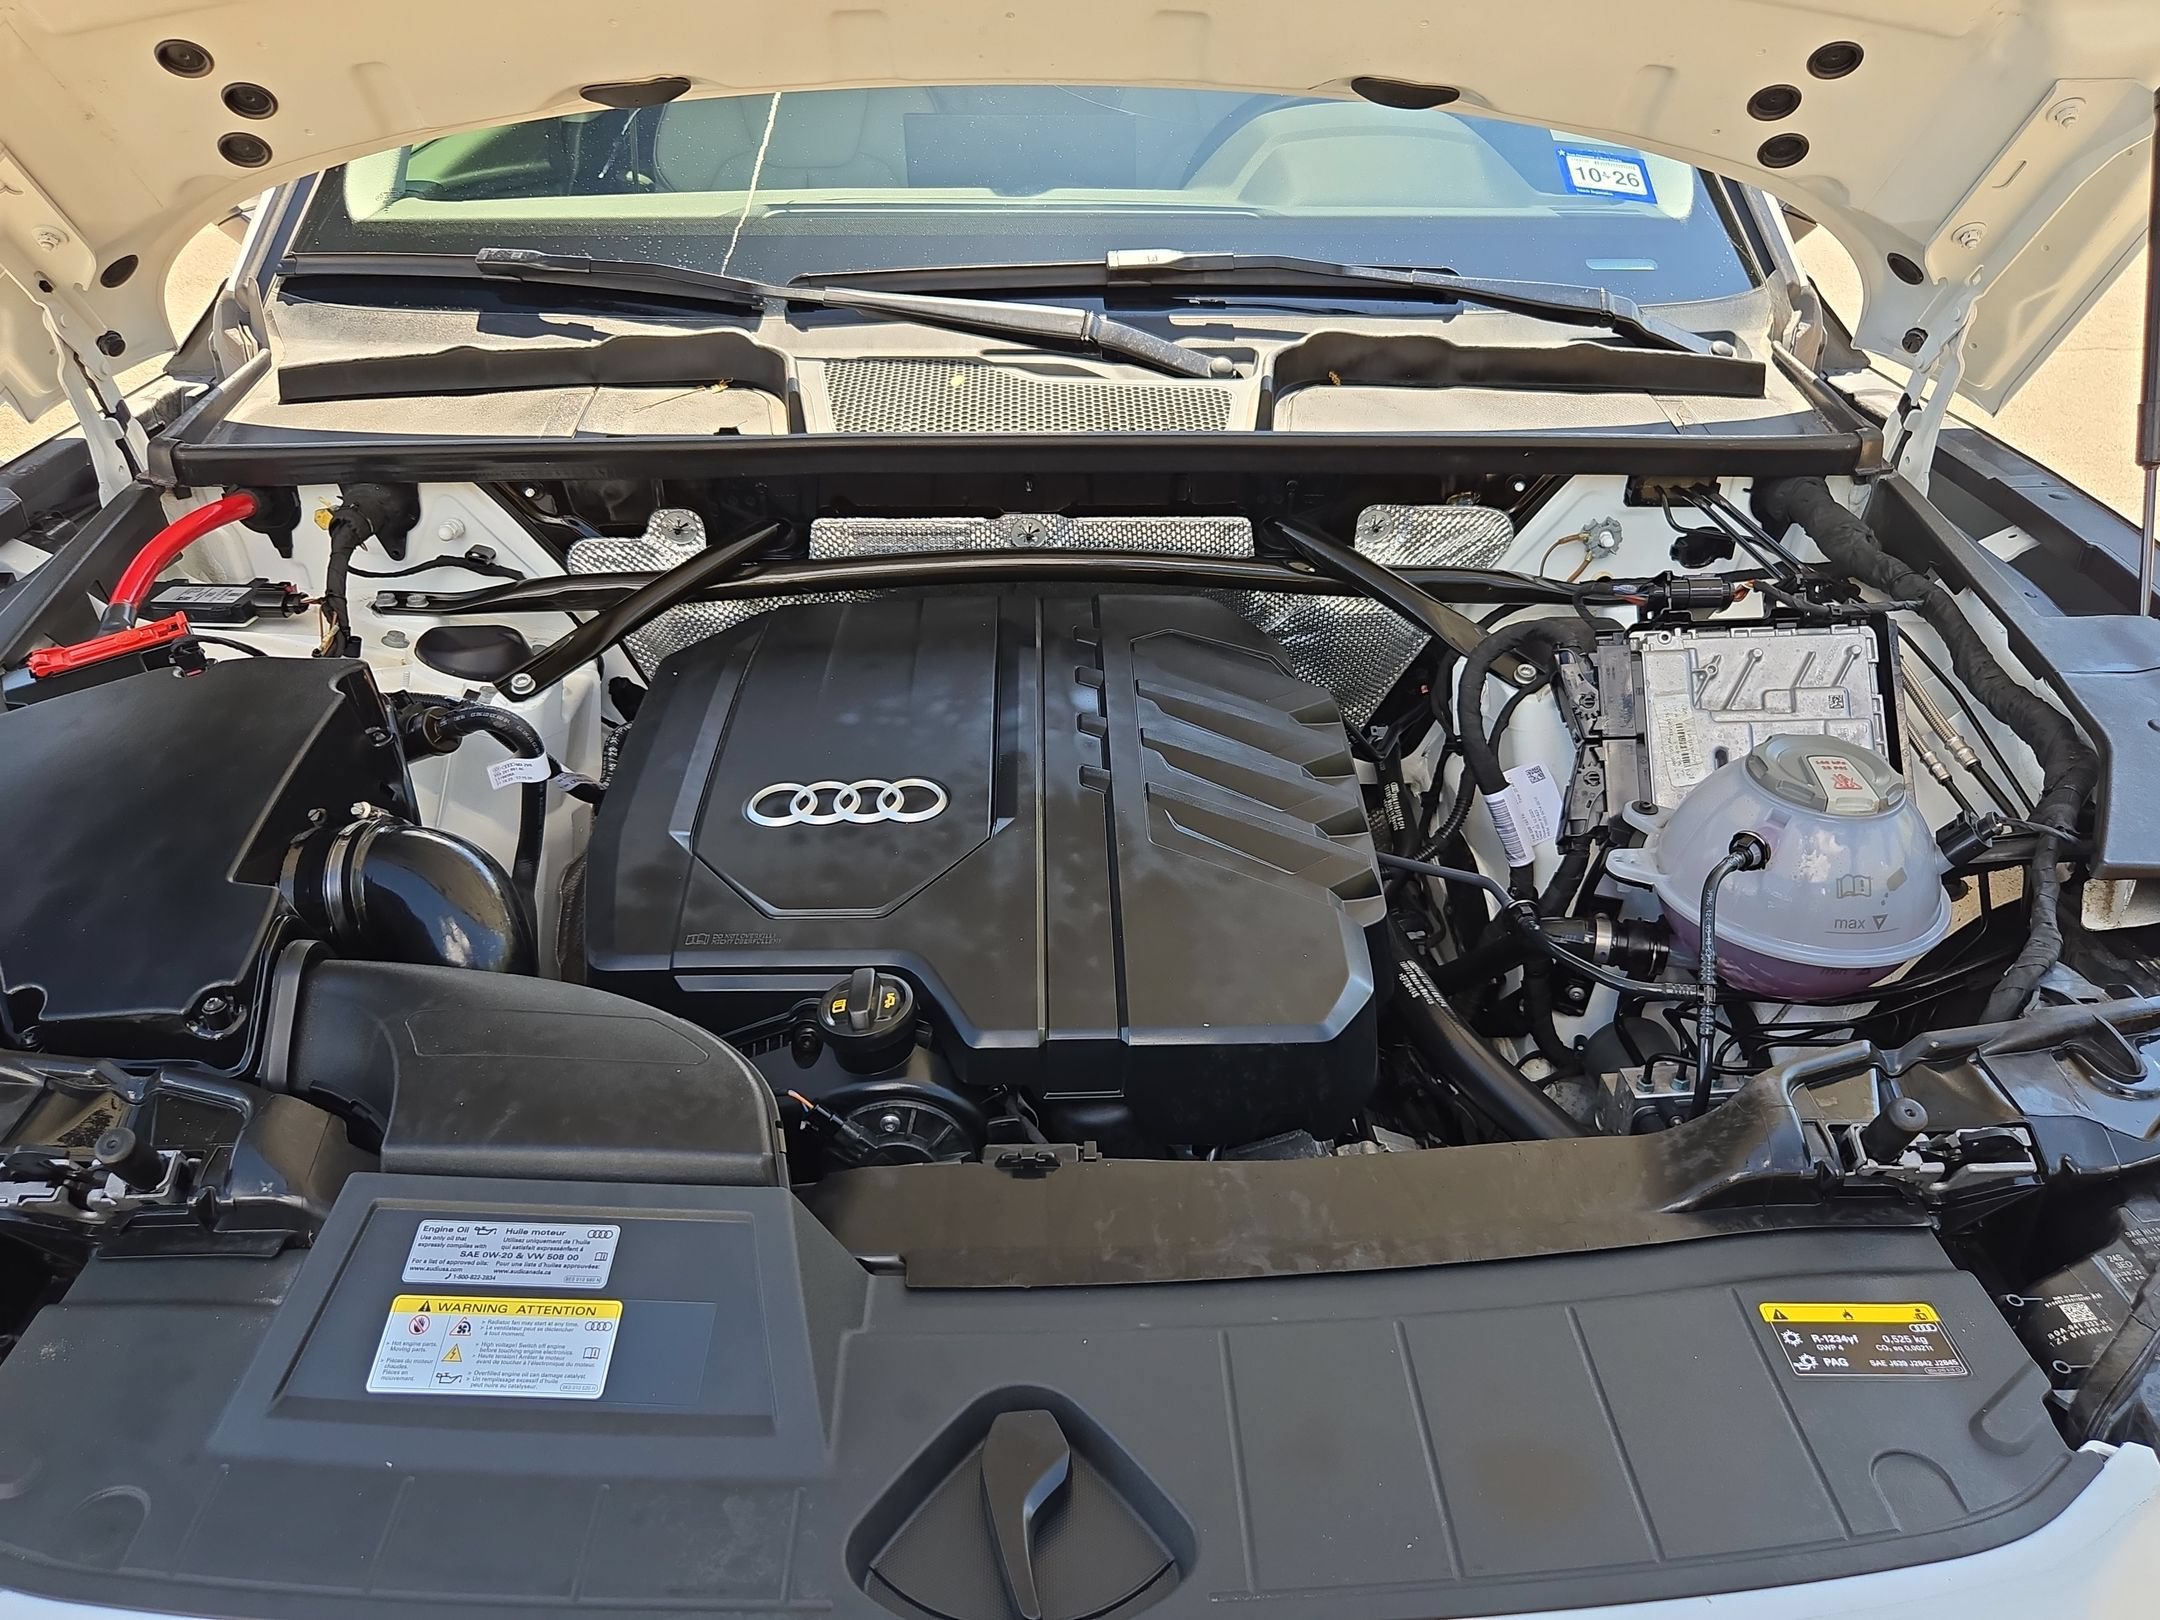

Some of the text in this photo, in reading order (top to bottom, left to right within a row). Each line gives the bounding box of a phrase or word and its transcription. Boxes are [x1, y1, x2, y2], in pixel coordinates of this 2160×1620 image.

[1576, 166, 1640, 187] 10 26
[1834, 919, 1866, 929] max
[423, 1225, 470, 1234] Engine Oil
[482, 1251, 513, 1259] 0W-20
[438, 1302, 597, 1316] WARNING ATTENTION
[1811, 1334, 1929, 1345] R-1234yf 0,525 kg
[1823, 1357, 1849, 1367] PAG
[1869, 1359, 1889, 1367] SAE
